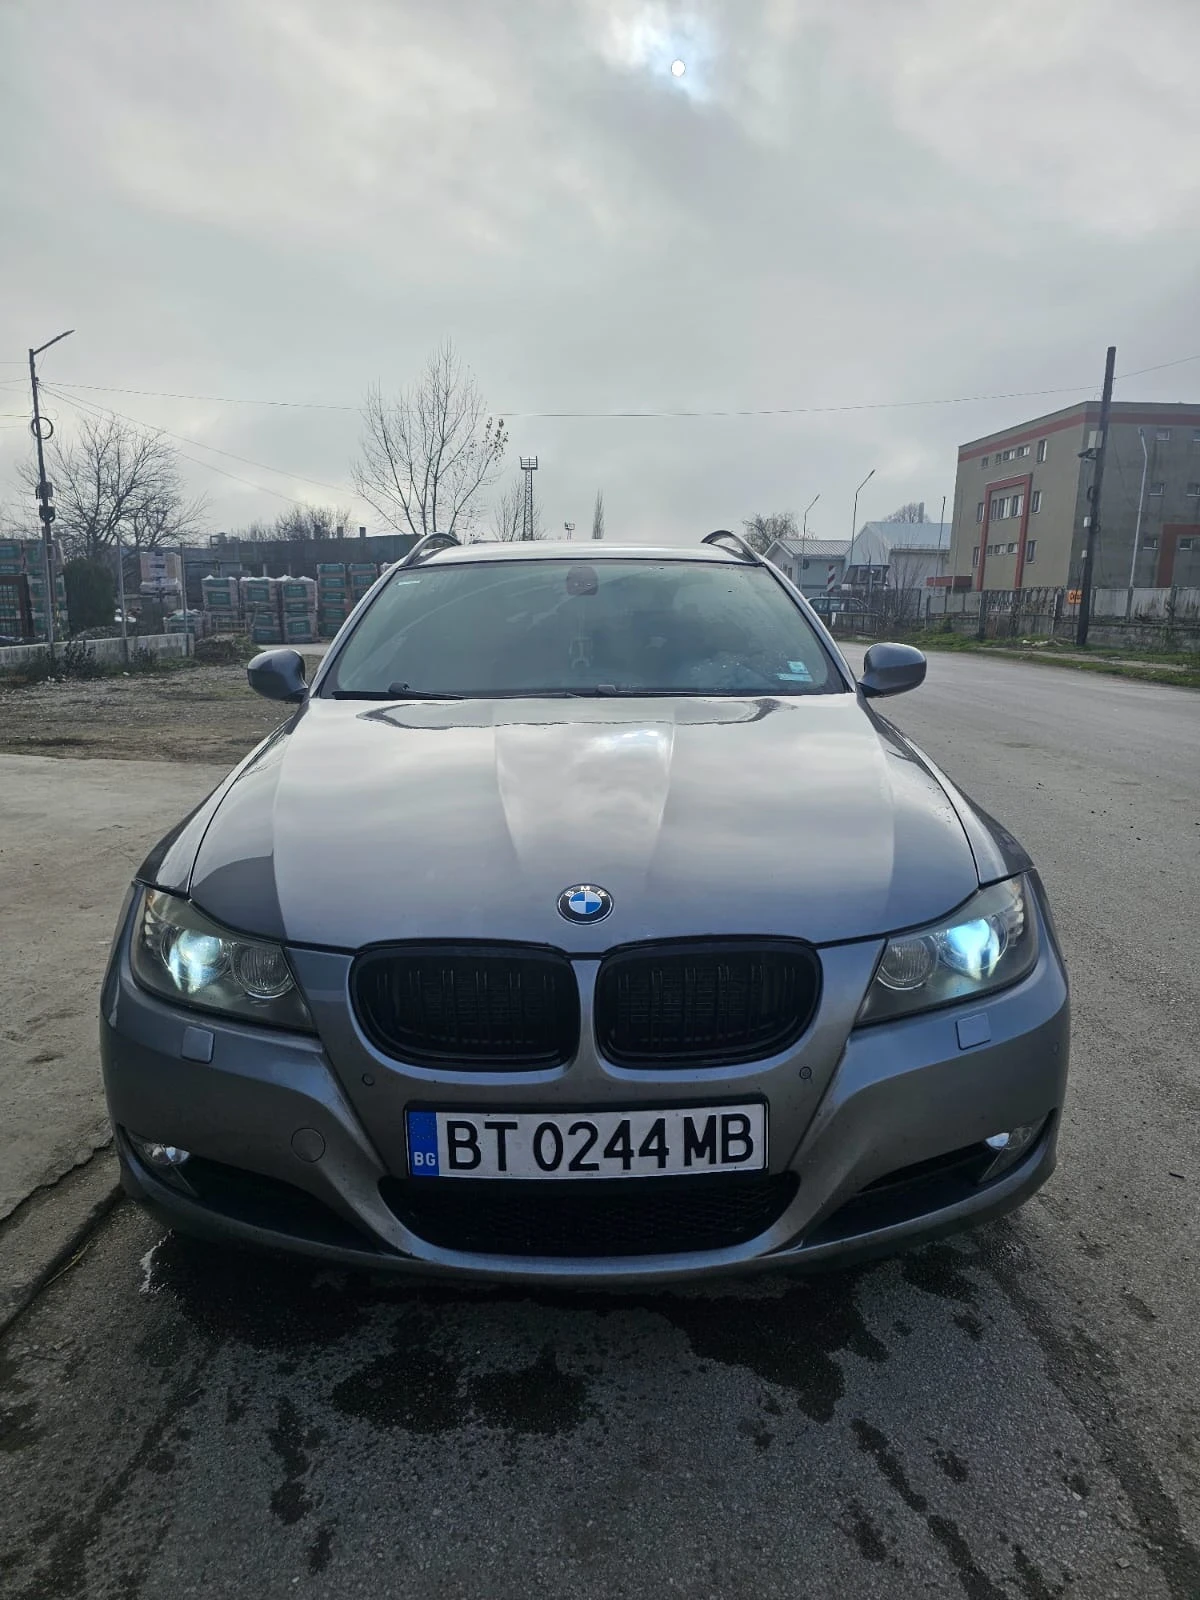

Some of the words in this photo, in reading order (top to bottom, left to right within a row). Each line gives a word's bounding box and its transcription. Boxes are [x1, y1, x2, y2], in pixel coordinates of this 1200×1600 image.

[564, 885, 607, 898] BMW
[446, 1120, 518, 1172] BT
[532, 1118, 670, 1172] 0244
[683, 1113, 754, 1167] MB
[413, 1151, 436, 1167] BG
